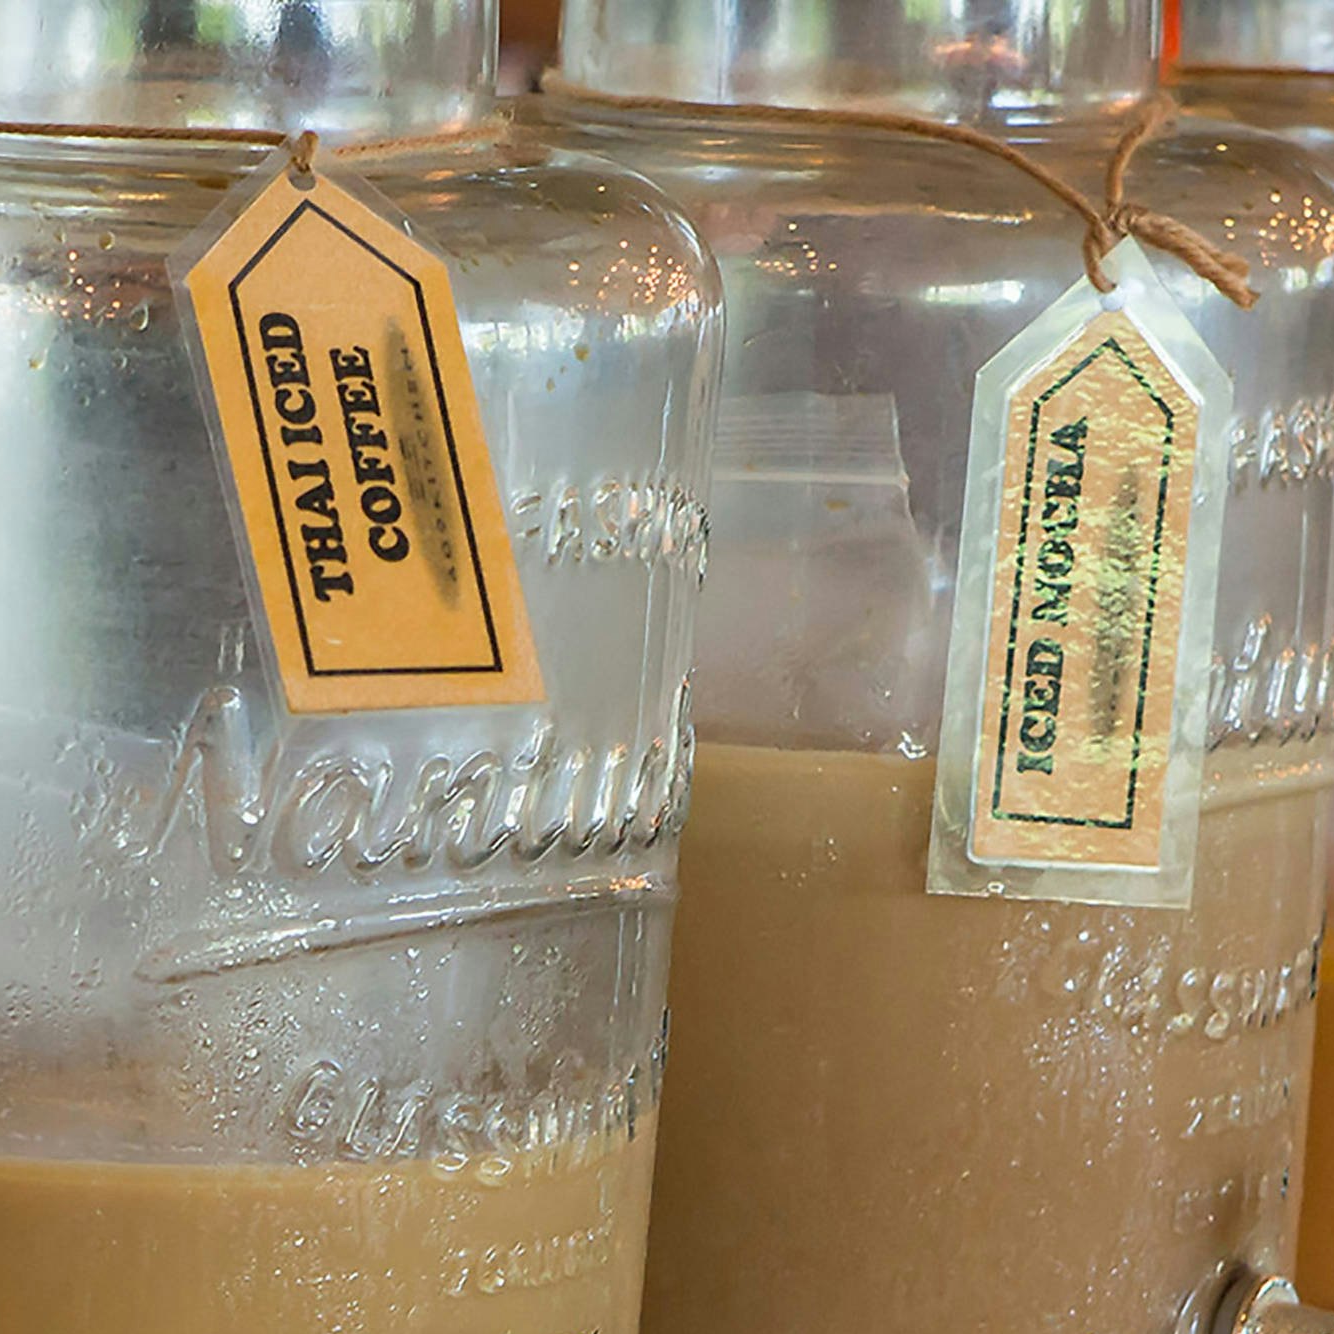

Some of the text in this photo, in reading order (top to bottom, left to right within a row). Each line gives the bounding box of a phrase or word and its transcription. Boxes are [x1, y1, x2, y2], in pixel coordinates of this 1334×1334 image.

[259, 311, 354, 603] THAI ICED
[328, 345, 410, 563] COFFEE
[1016, 415, 1089, 777] ICED MOCHA
